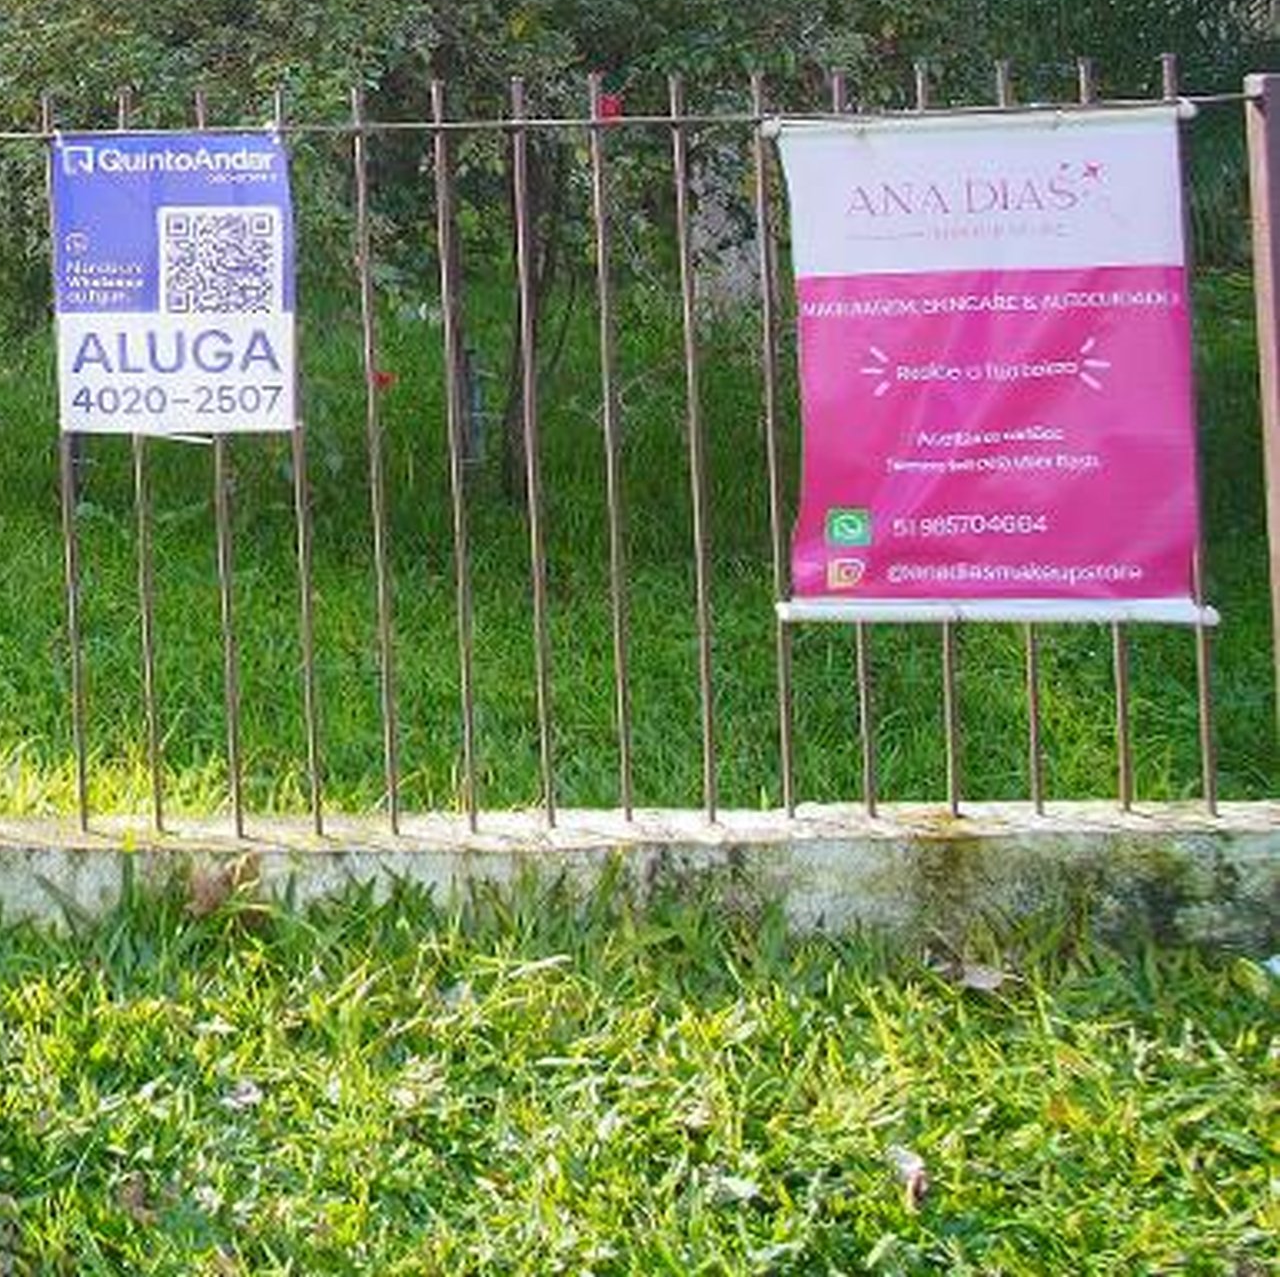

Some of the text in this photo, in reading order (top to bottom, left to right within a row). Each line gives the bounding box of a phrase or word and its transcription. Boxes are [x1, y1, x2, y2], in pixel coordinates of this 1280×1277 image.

[98, 147, 277, 172] QuintoAndar
[846, 175, 1080, 216] ANA DIAS
[72, 329, 281, 374] ALUGA
[72, 385, 283, 415] 4020-2507
